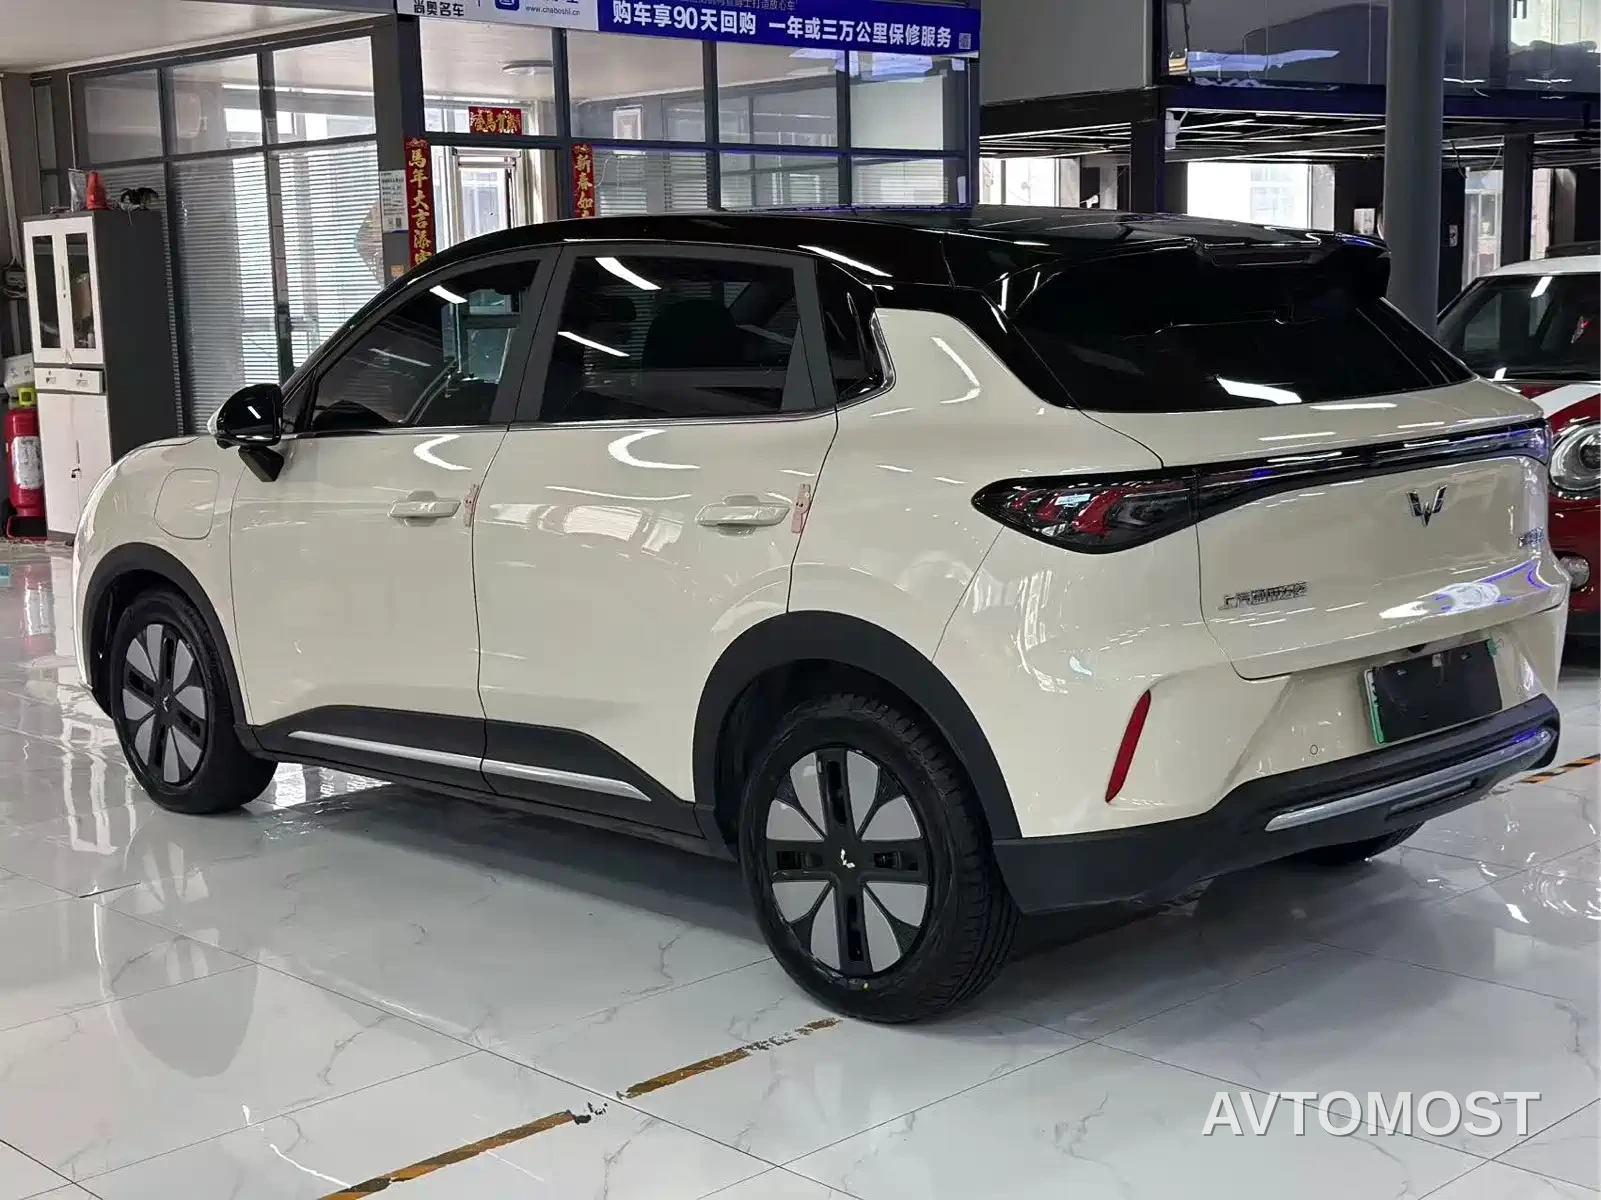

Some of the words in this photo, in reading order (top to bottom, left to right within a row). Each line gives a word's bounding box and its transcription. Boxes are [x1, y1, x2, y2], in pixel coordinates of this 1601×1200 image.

[413, 0, 465, 17] 尚奥名车
[613, 1, 756, 35] 购车享90天回购
[768, 16, 951, 48] 一年或三万公里保修服务
